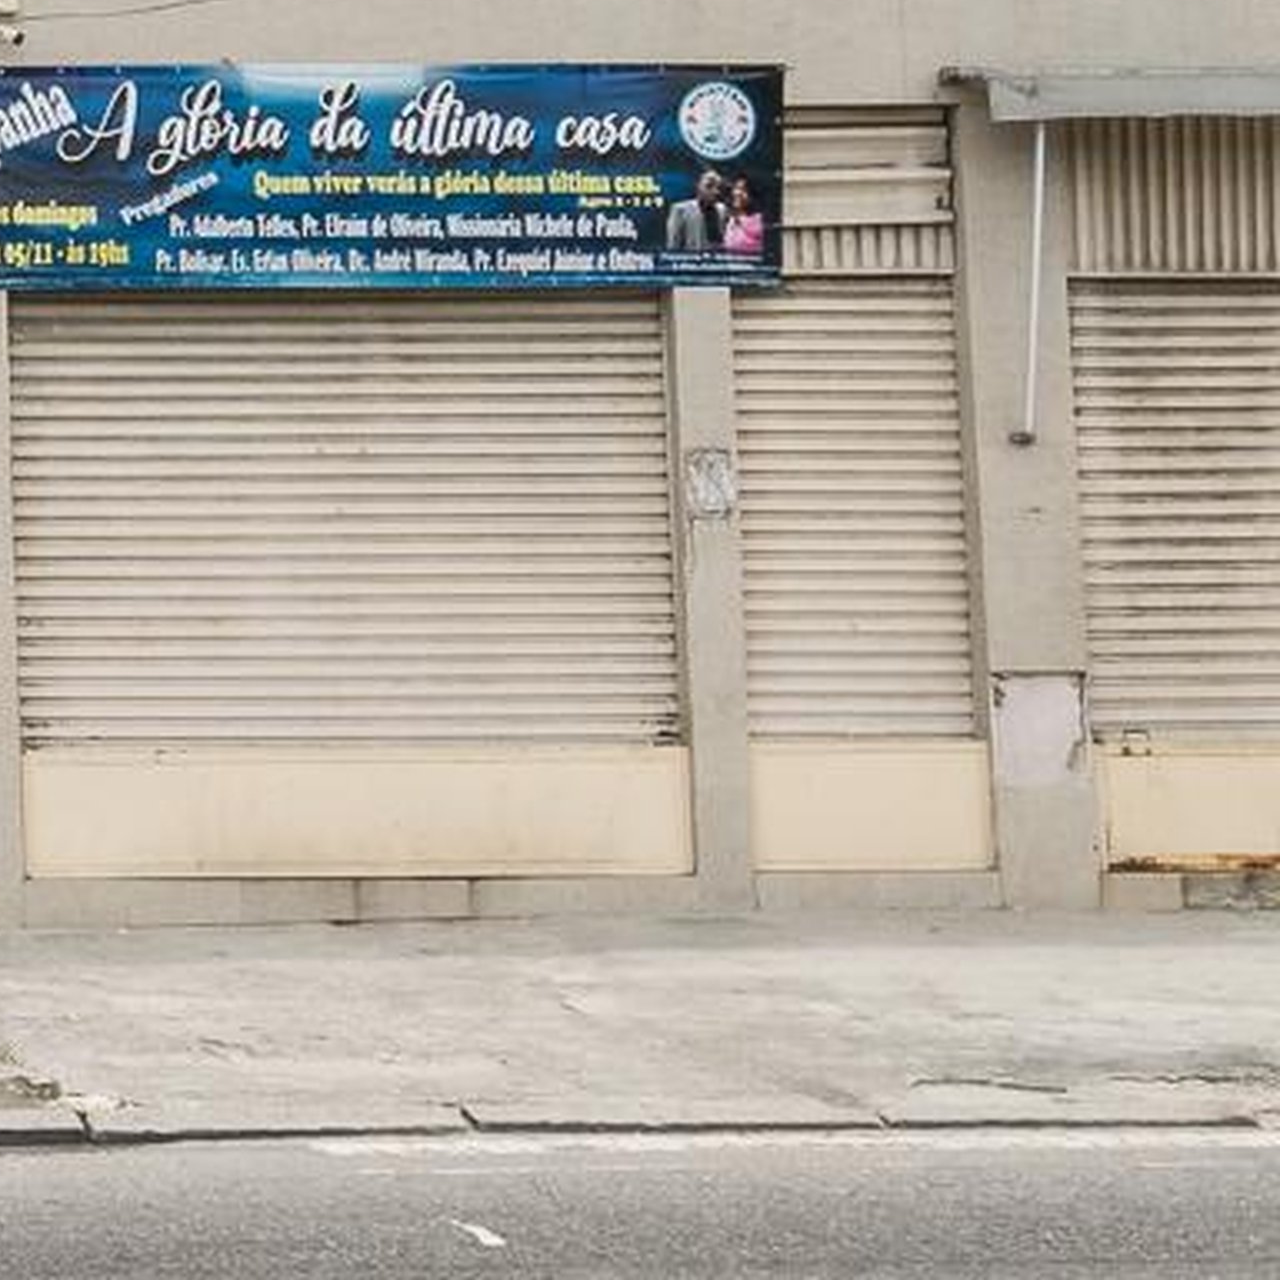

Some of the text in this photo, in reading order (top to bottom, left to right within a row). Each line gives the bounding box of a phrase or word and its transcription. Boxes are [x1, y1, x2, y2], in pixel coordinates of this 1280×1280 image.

[55, 80, 138, 162] A
[310, 80, 371, 154] da
[390, 79, 537, 157] última
[555, 114, 653, 154] casa
[253, 170, 311, 199] Quem
[313, 170, 363, 195] viver
[419, 175, 431, 195] a
[434, 169, 490, 200] glória
[548, 169, 610, 194] última
[12, 199, 98, 231] domingos
[168, 213, 191, 238] Pr.
[371, 213, 388, 238] de
[446, 212, 521, 238] Missionária
[576, 212, 592, 238] de
[473, 247, 494, 273] Pr.
